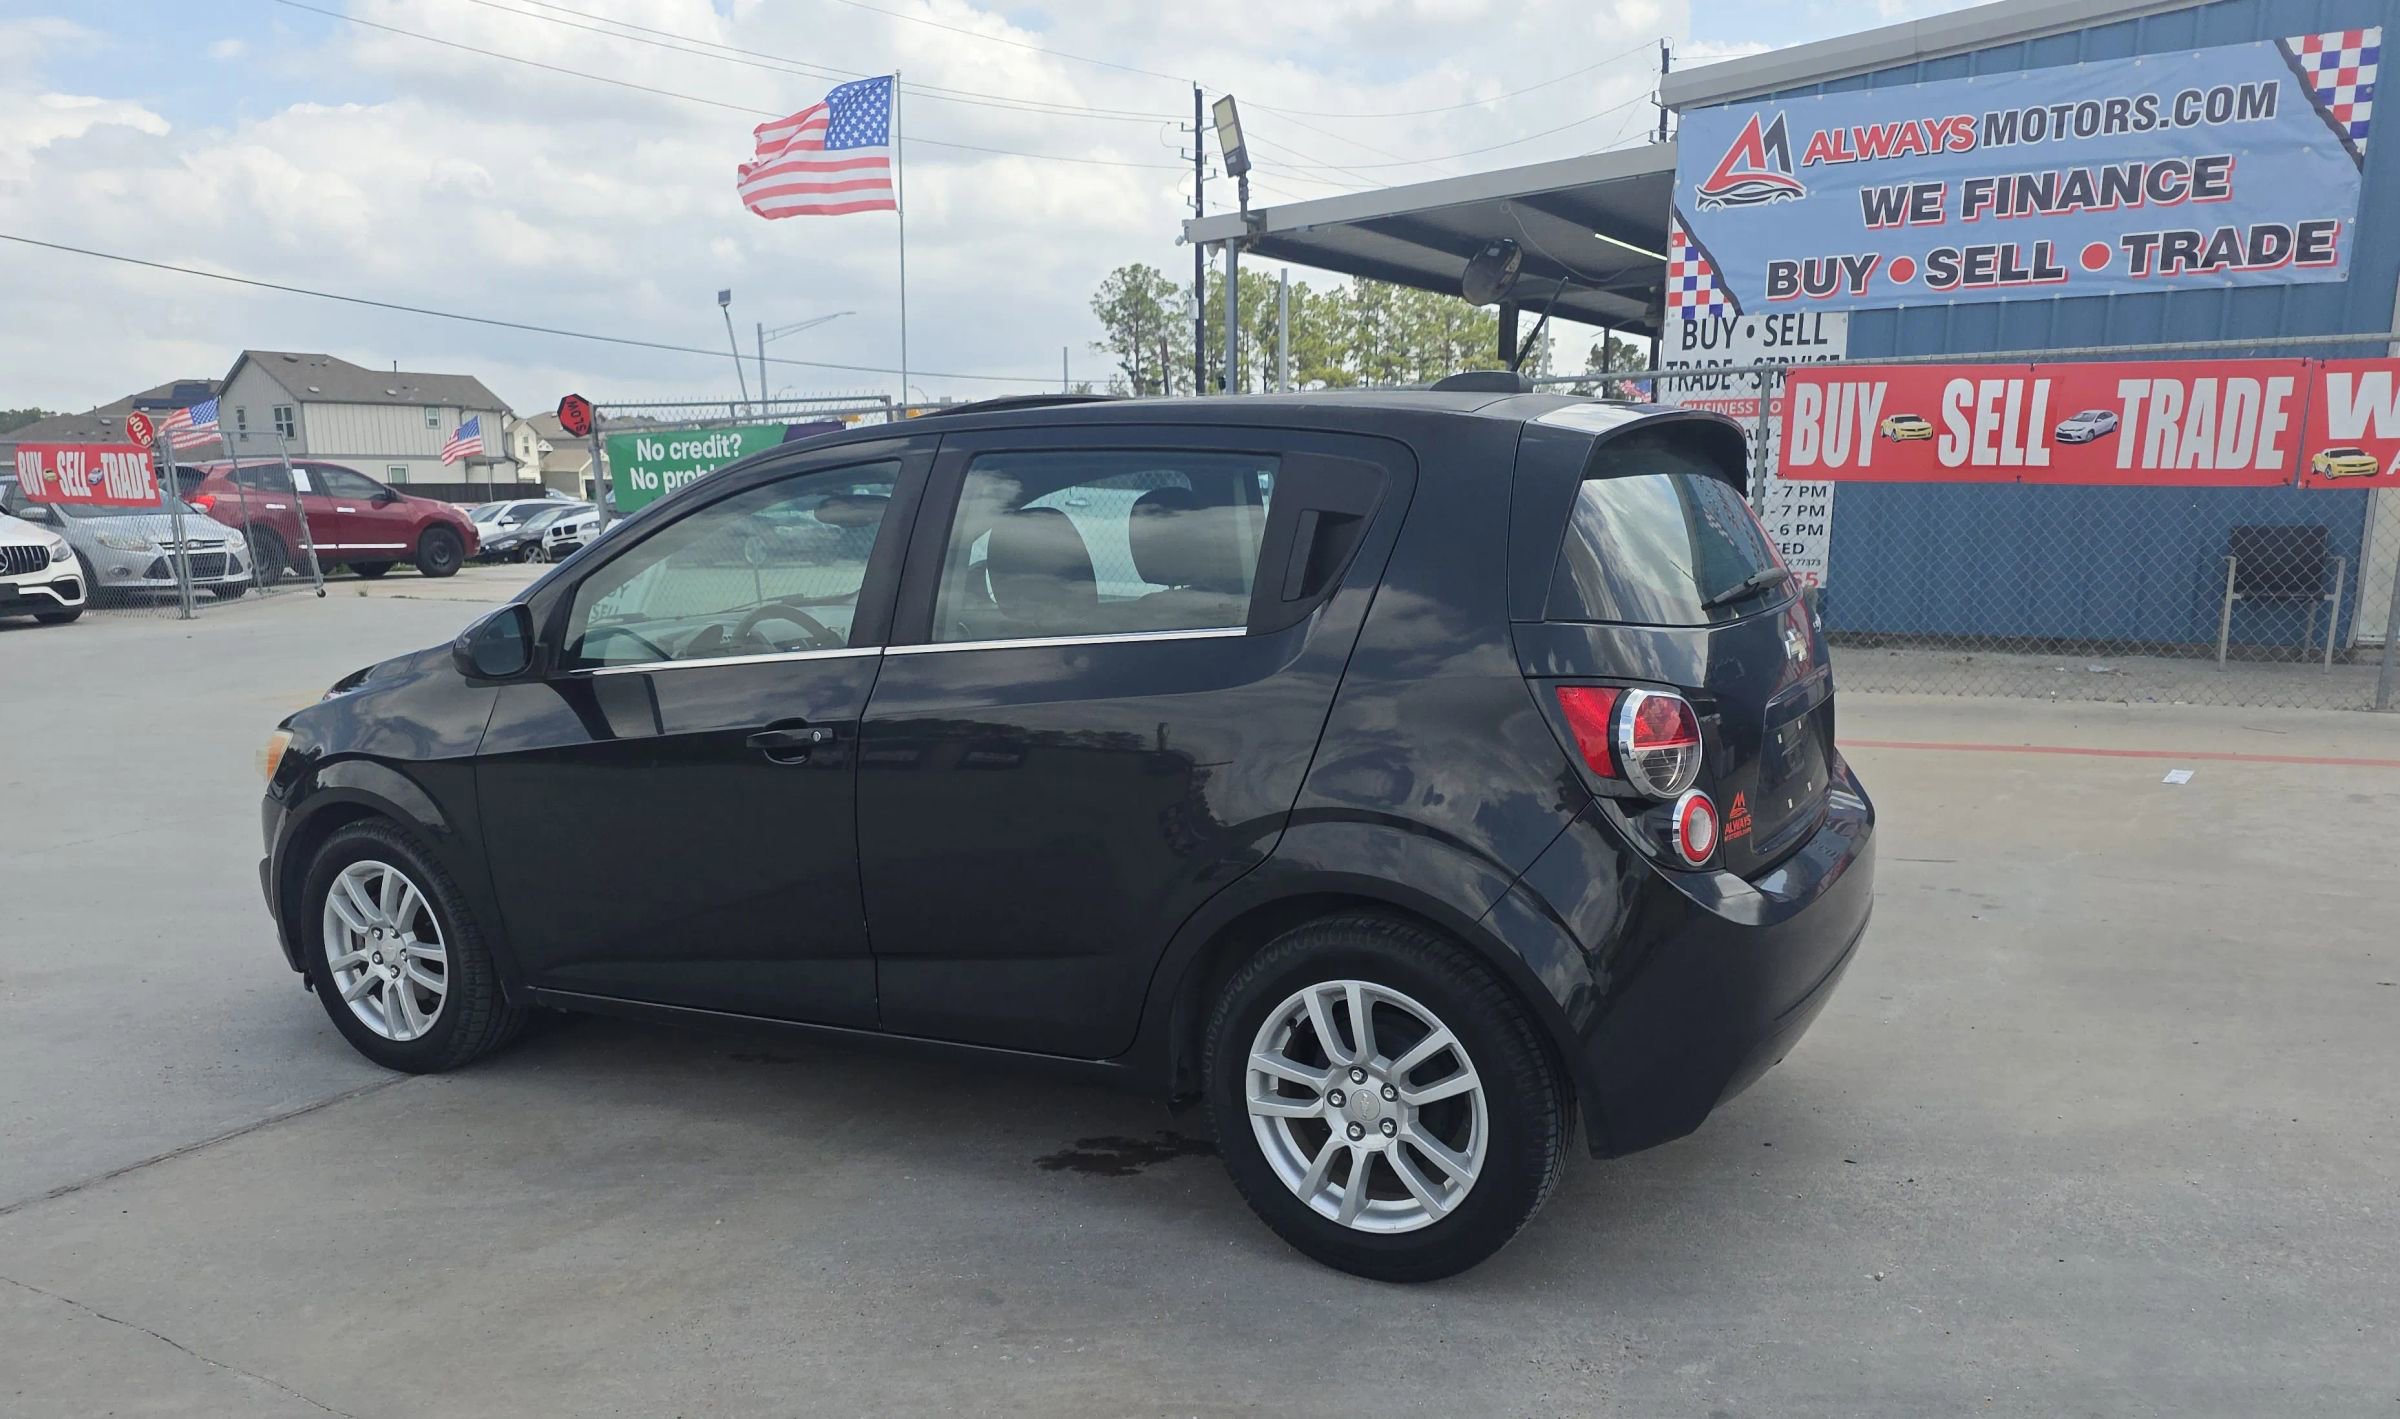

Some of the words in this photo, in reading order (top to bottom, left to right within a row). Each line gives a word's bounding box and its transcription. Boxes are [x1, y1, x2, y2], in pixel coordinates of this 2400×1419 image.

[1859, 181, 1948, 230] WE
[1960, 154, 2236, 222] FINANCE
[1765, 252, 1882, 301] BUY
[1924, 239, 2069, 291] SELL
[2119, 219, 2341, 279] TRADE
[1682, 316, 1739, 350] BUY
[1763, 312, 1828, 347] SELL
[1666, 358, 1732, 392] TRADE
[128, 415, 152, 446] STOP
[566, 400, 587, 432] SLOW
[1789, 381, 1888, 469] BUY
[1937, 377, 2051, 469] SELL
[2115, 376, 2295, 470] TRADE
[636, 439, 664, 462] No
[669, 433, 742, 460] credit?
[18, 452, 46, 496] BUY
[57, 451, 92, 497] SELL
[100, 453, 156, 499] TRADE
[630, 467, 659, 490] No
[1783, 486, 1794, 498] 7
[1799, 485, 1827, 498] PM
[1781, 505, 1792, 517] 7
[1797, 505, 1825, 517] PM
[1779, 524, 1790, 536] 6
[1795, 524, 1823, 536] PM
